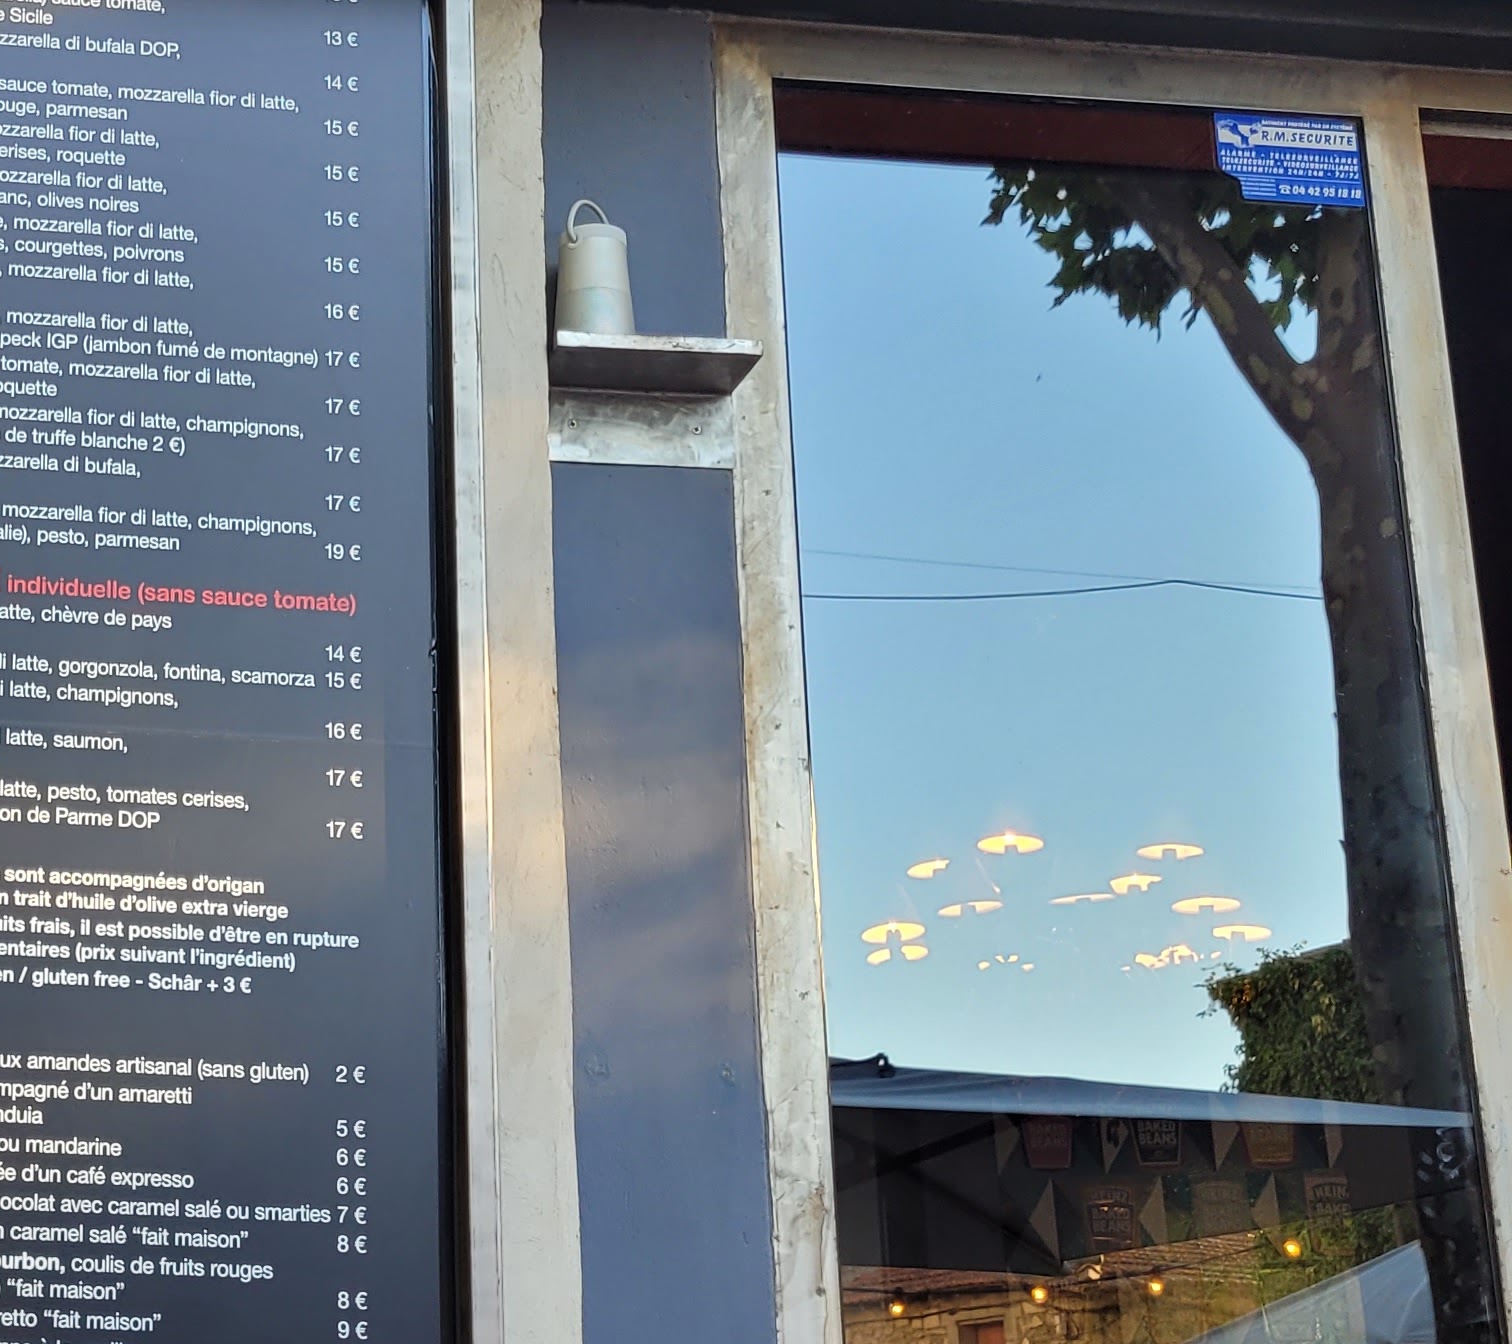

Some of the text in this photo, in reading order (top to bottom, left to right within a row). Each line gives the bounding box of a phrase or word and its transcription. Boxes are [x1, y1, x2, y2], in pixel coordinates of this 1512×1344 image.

[68, 126, 96, 142] fior
[100, 128, 115, 143] di
[121, 129, 159, 149] latte,
[1292, 185, 1305, 195] 04
[1308, 186, 1320, 196] 42
[1338, 188, 1349, 198] 18
[1351, 189, 1361, 199] 18
[324, 303, 343, 319] 16
[348, 305, 359, 320] €
[8, 575, 131, 599] individuelle
[138, 582, 195, 605] (sans
[202, 590, 267, 607] sauce
[274, 590, 356, 616] tomate)
[325, 722, 345, 739] 16
[350, 723, 362, 740] €
[25, 1137, 122, 1156] mandarine
[336, 1148, 348, 1166] 6
[354, 1149, 366, 1167] €
